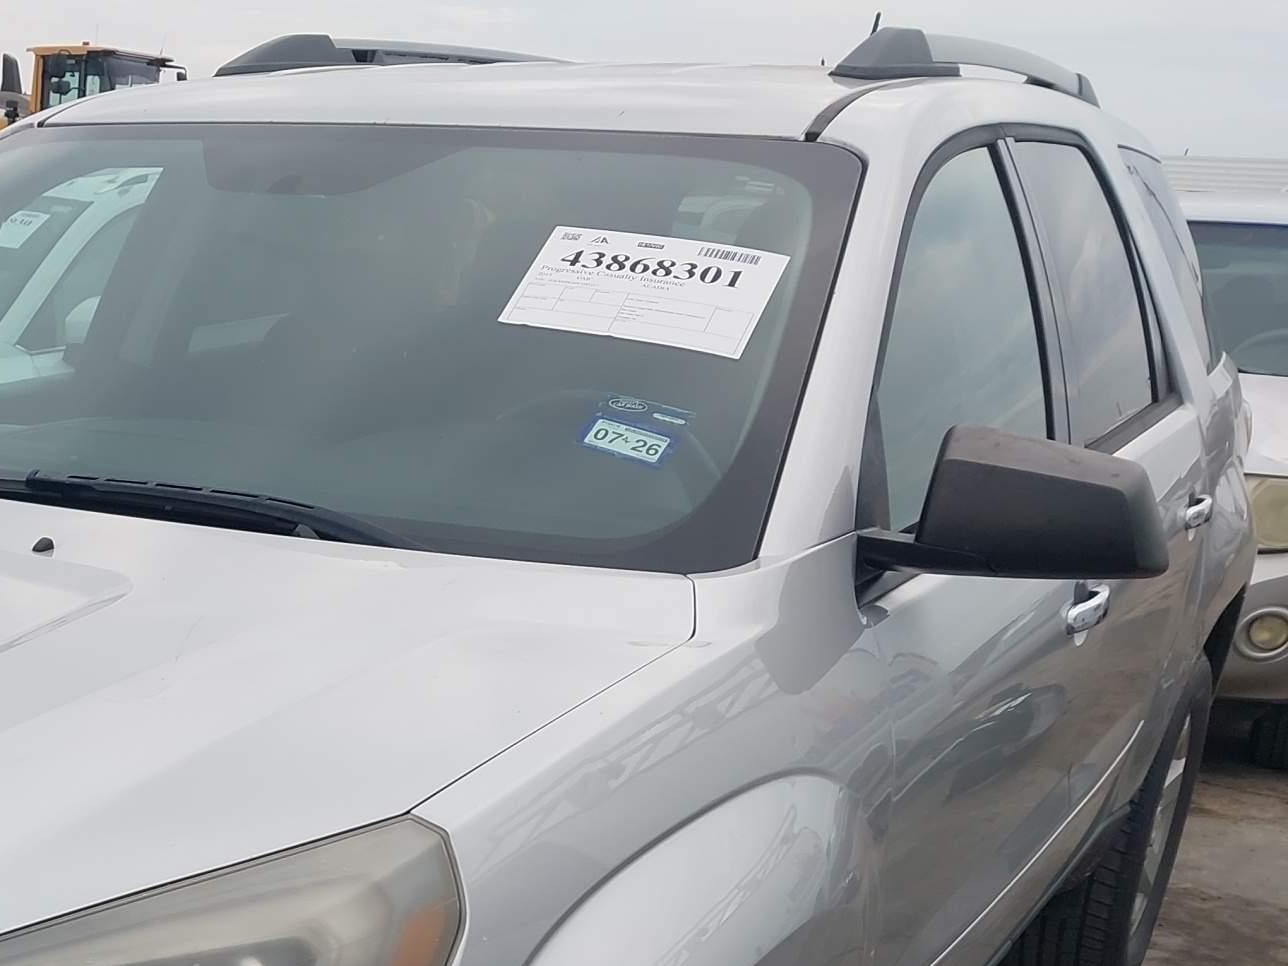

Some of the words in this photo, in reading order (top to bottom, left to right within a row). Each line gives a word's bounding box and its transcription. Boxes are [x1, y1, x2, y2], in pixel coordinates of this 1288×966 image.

[541, 264, 595, 277] Progressive
[597, 268, 637, 281] Casualty
[560, 249, 744, 288] 43868301
[593, 427, 625, 444] 07
[630, 438, 662, 457] 26
